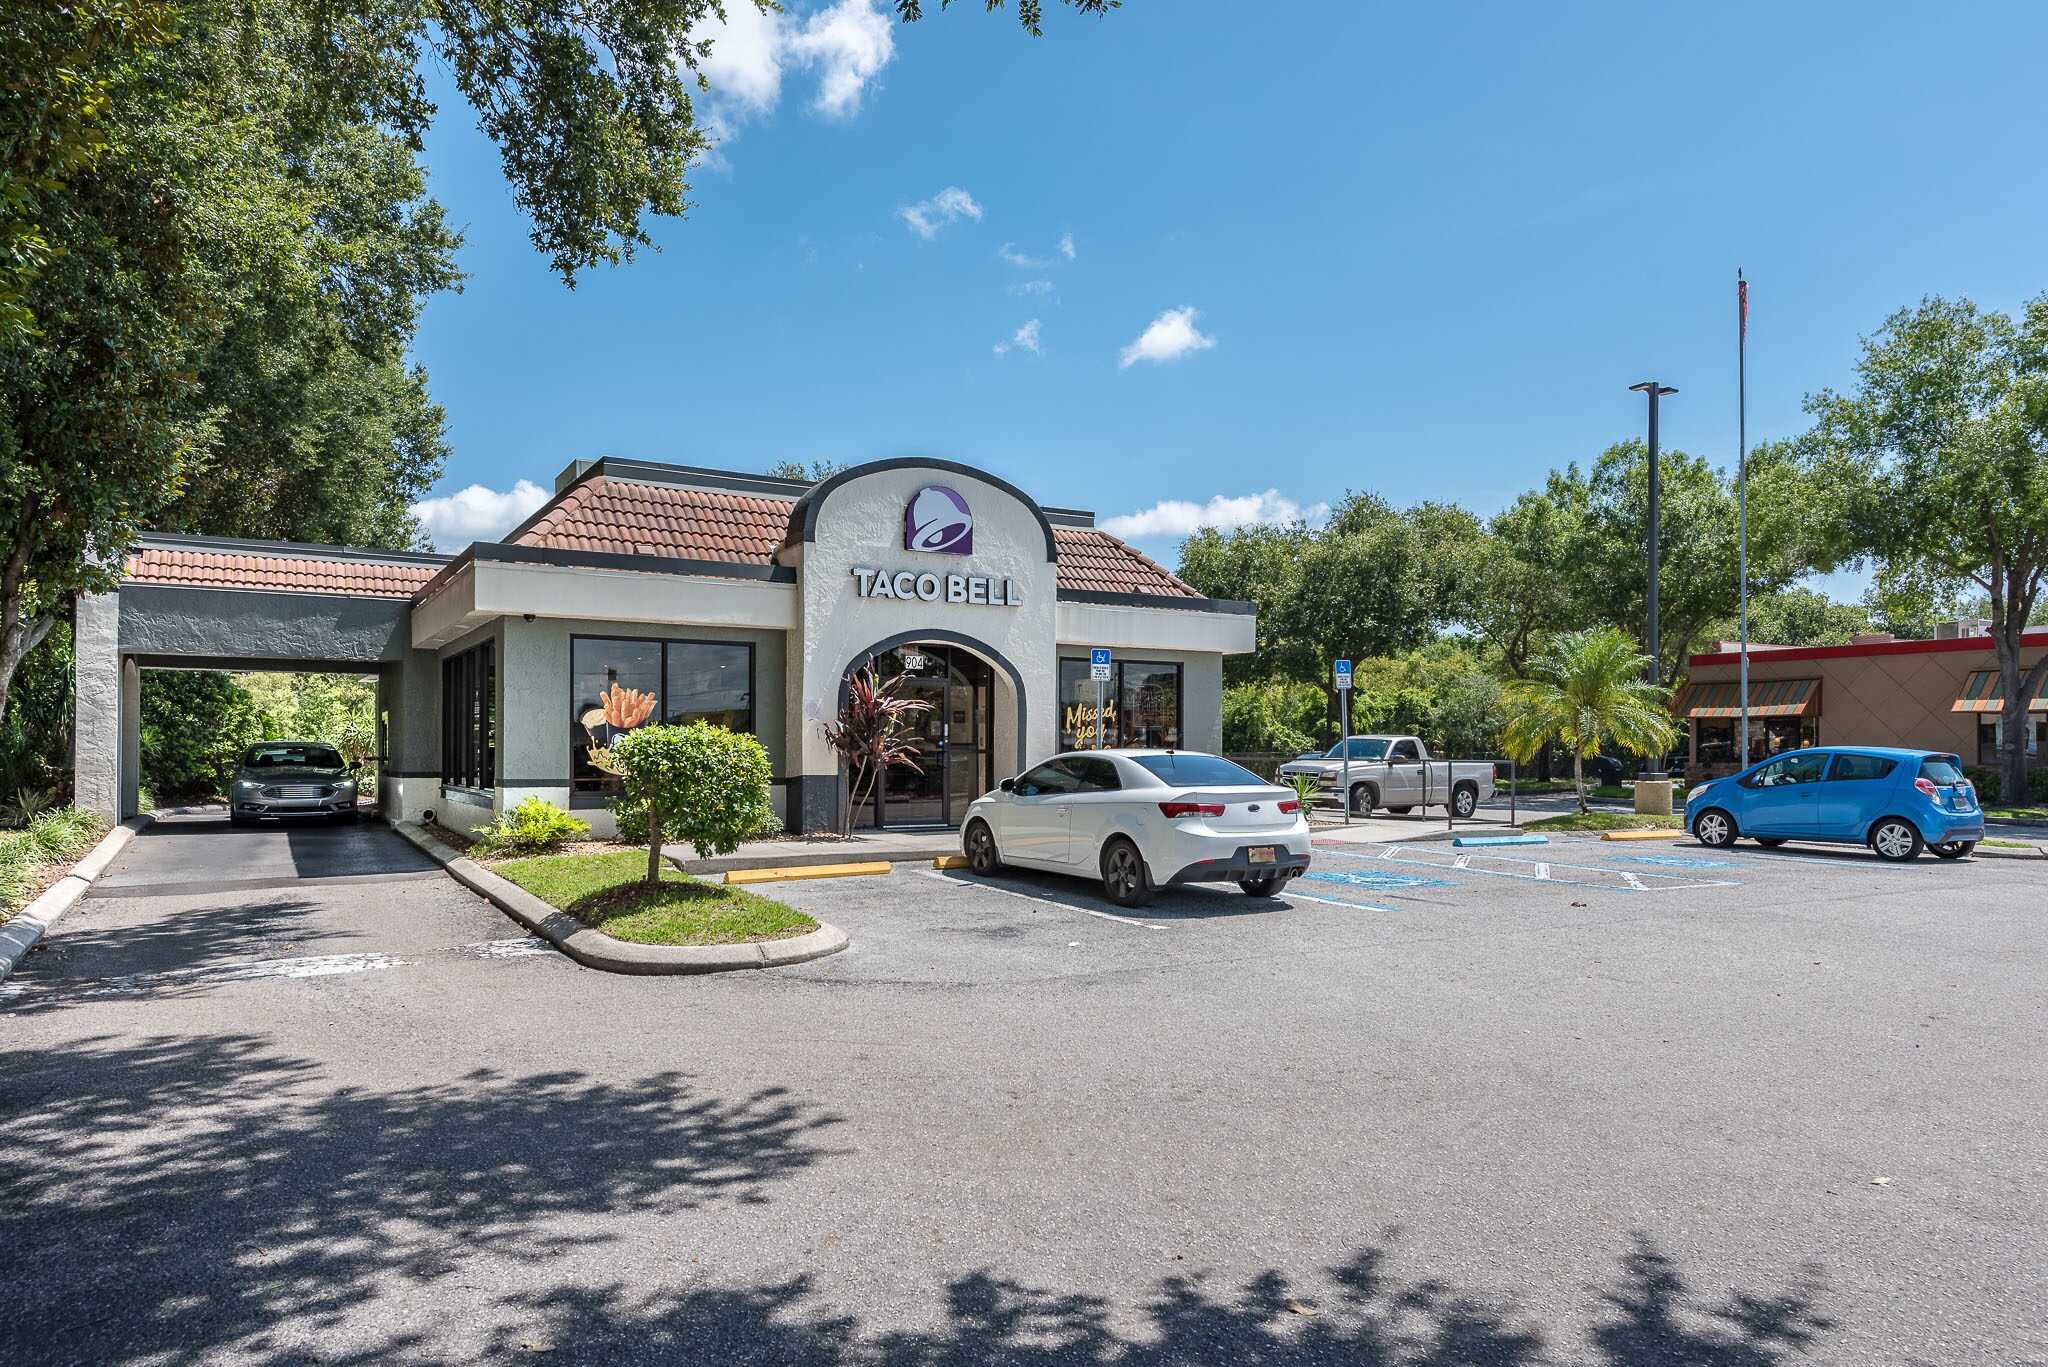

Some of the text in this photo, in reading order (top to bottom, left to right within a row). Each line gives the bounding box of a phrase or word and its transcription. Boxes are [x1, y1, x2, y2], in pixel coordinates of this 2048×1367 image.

[853, 567, 1023, 606] TACO BELL
[906, 656, 923, 669] 904
